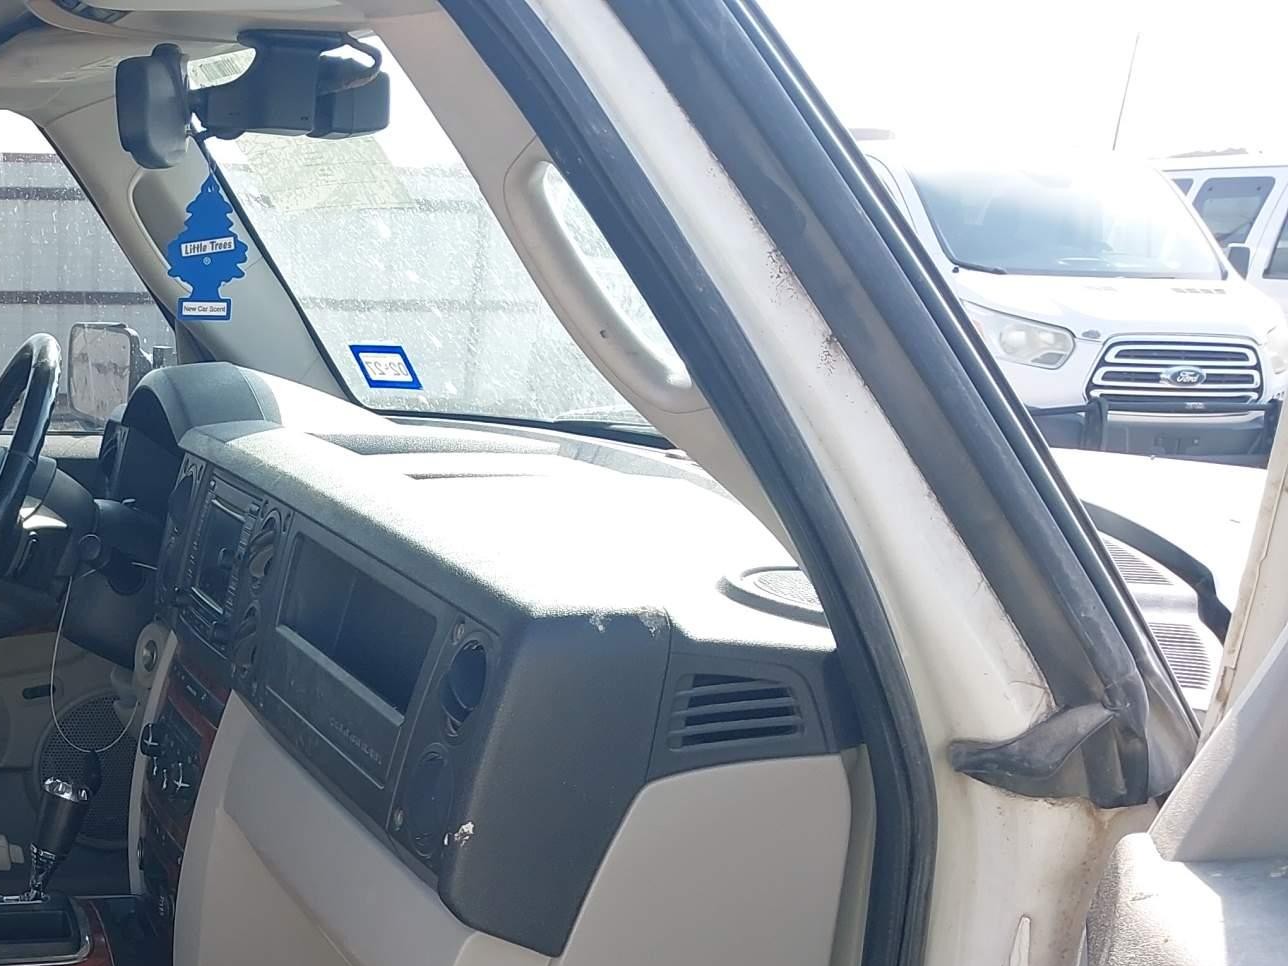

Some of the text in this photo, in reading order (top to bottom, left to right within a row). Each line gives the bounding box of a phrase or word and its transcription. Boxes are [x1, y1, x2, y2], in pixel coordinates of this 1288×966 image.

[184, 240, 232, 255] Little Trees
[1176, 371, 1200, 383] Ford
